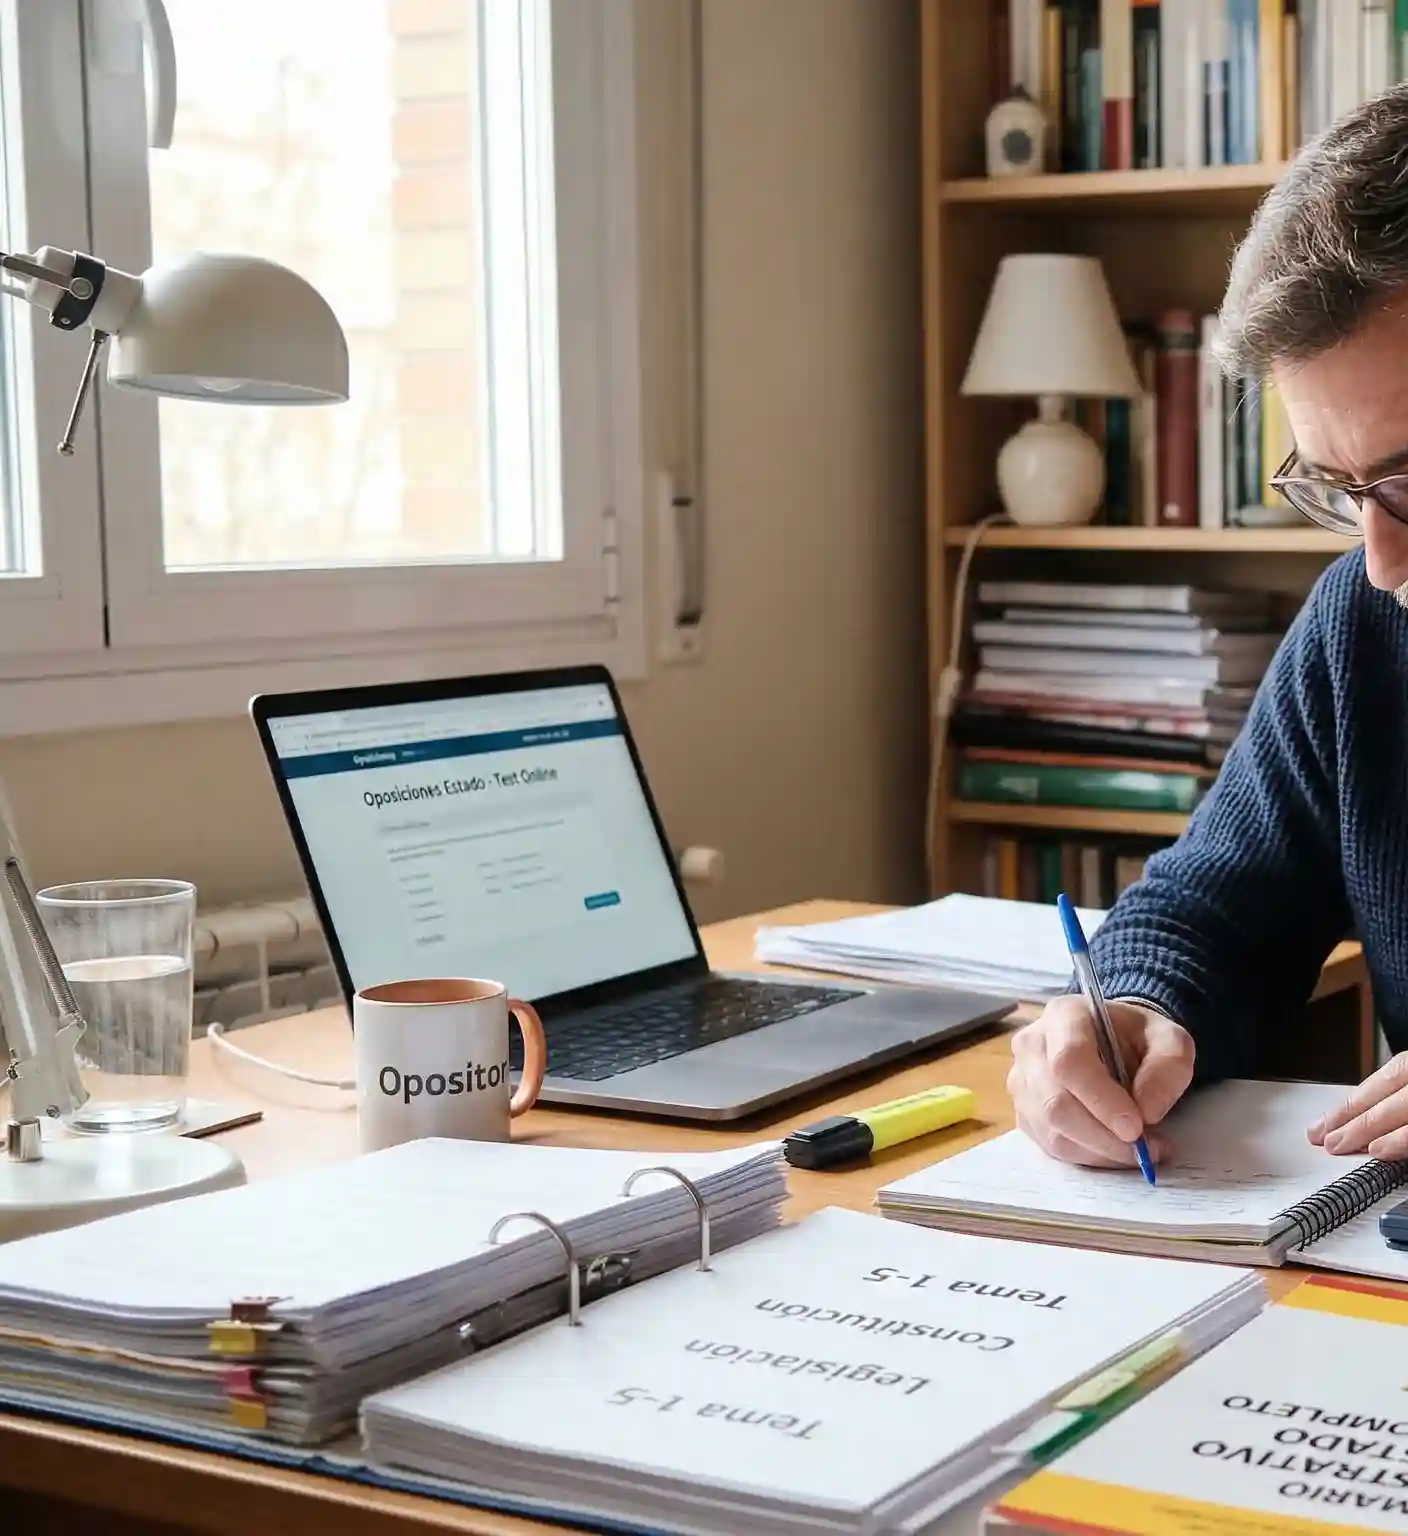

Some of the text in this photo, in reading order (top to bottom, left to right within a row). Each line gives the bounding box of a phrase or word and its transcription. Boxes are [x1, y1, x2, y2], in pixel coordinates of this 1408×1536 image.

[363, 783, 443, 810] Oposiciones
[444, 775, 486, 797] Estado
[493, 770, 519, 789] Test
[521, 767, 558, 785] Online
[379, 1060, 509, 1104] Opositor
[862, 1266, 1070, 1312] Tema 1-5
[754, 1298, 1017, 1352] Constitución
[682, 1338, 931, 1397] Legislación
[607, 1386, 826, 1440] Tema 1-5
